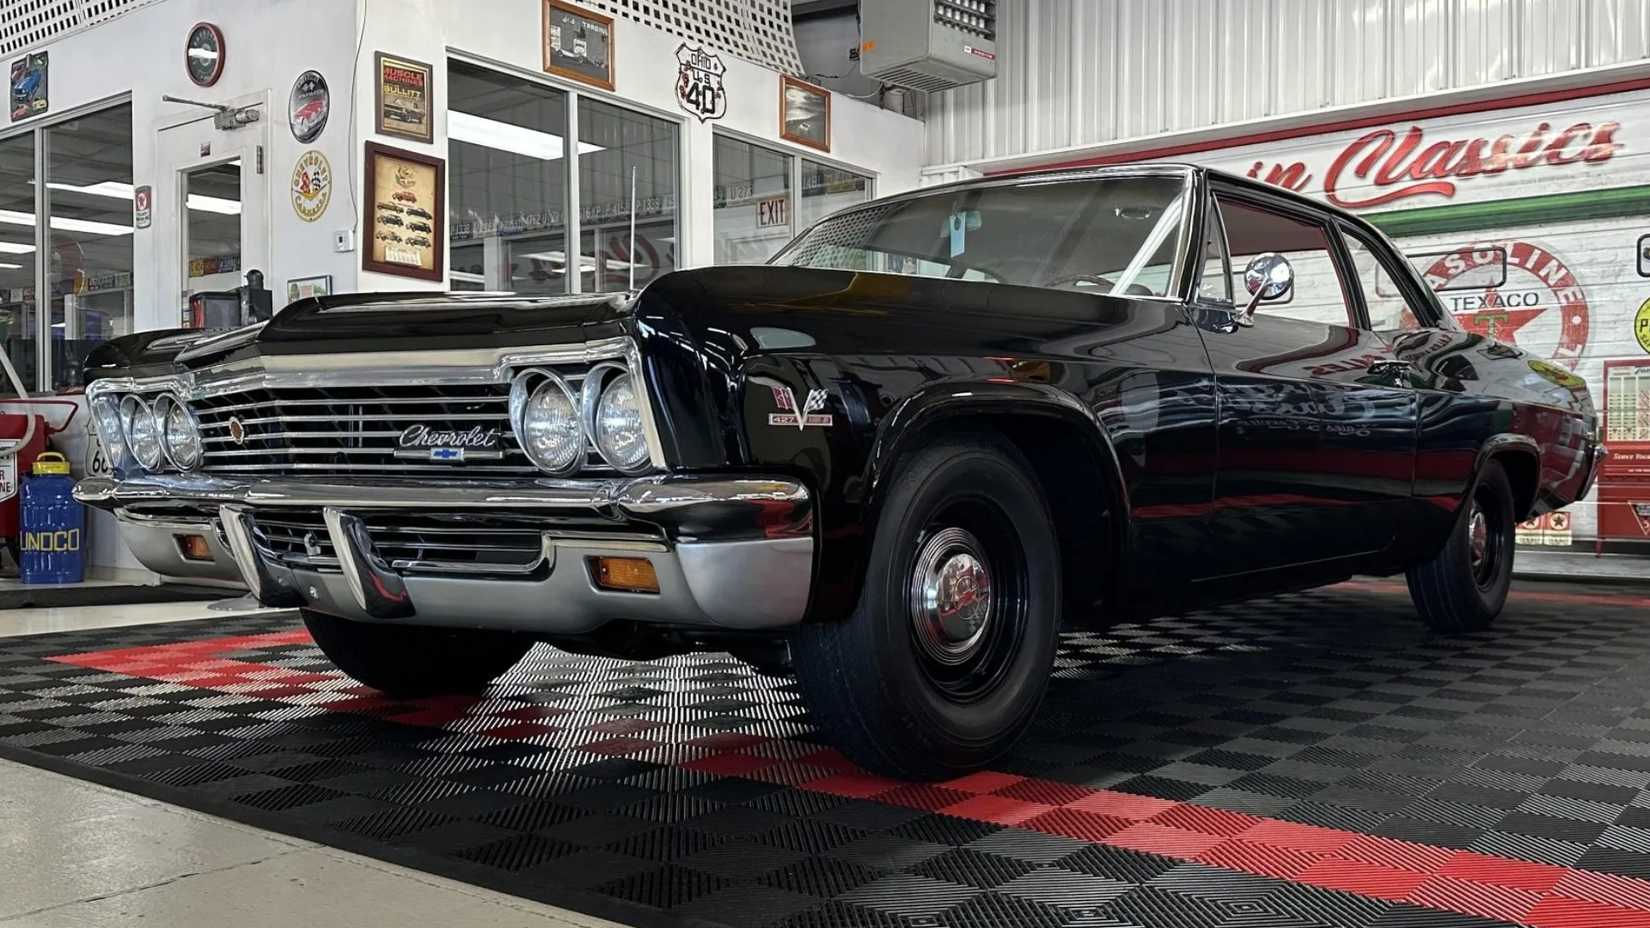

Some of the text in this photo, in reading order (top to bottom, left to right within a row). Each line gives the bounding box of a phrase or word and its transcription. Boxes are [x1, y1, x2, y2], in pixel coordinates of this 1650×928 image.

[686, 82, 715, 114] 40
[1324, 122, 1627, 209] Classics
[759, 199, 785, 226] EXIT
[1424, 241, 1584, 305] ASOLINE
[1451, 291, 1540, 312] TEXACO
[399, 424, 501, 447] Chevrolet
[19, 528, 80, 551] UNOCO
